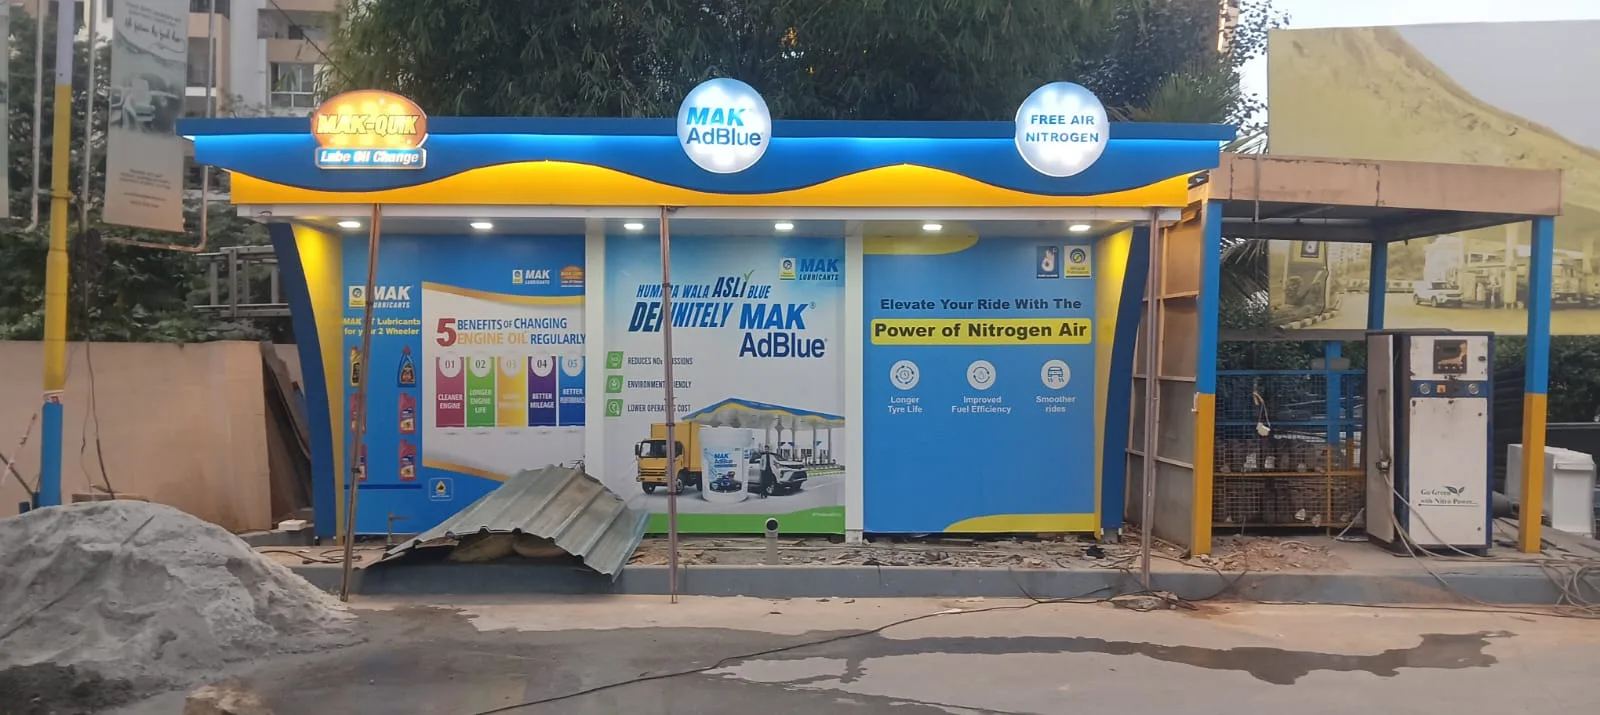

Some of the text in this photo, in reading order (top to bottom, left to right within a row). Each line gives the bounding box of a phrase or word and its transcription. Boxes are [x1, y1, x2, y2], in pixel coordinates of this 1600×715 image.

[685, 106, 747, 127] MAK
[1031, 114, 1095, 125] FREE AIR
[315, 114, 421, 138] MAK-QUIK
[686, 127, 761, 146] AdBlue
[1025, 132, 1099, 142] NITROGEN
[320, 150, 418, 165] Lube Oil Change
[800, 258, 839, 273] MAK
[525, 269, 550, 279] MAK
[682, 284, 709, 298] WALA
[747, 285, 772, 299] BLUE
[880, 298, 1082, 310] Elevate Your Ride With The
[377, 316, 421, 325] Lubricants
[739, 303, 808, 330] MAK
[344, 327, 357, 335] for
[378, 327, 384, 335] 2
[386, 327, 420, 335] Wheeler
[436, 317, 568, 347] 5 BENEFITS OF CHANGING
[874, 322, 1088, 341] Power of Nitrogen Air
[457, 332, 586, 345] ENGINE OIL REGULARLY
[739, 332, 826, 358] AdBlue
[445, 359, 456, 369] 01
[475, 359, 486, 369] 02
[537, 359, 548, 369] 04
[567, 359, 578, 368] 05
[628, 357, 651, 365] REDUCES
[438, 393, 463, 401] CLEANER
[890, 396, 920, 405] Longer
[963, 395, 1002, 405] Improved
[1035, 395, 1076, 404] Smoother
[628, 404, 646, 412] LOWER
[677, 404, 691, 412] COST
[888, 405, 923, 414] Tyre Life
[951, 405, 1012, 414] Fuel Efficiency
[1045, 405, 1066, 413] rides
